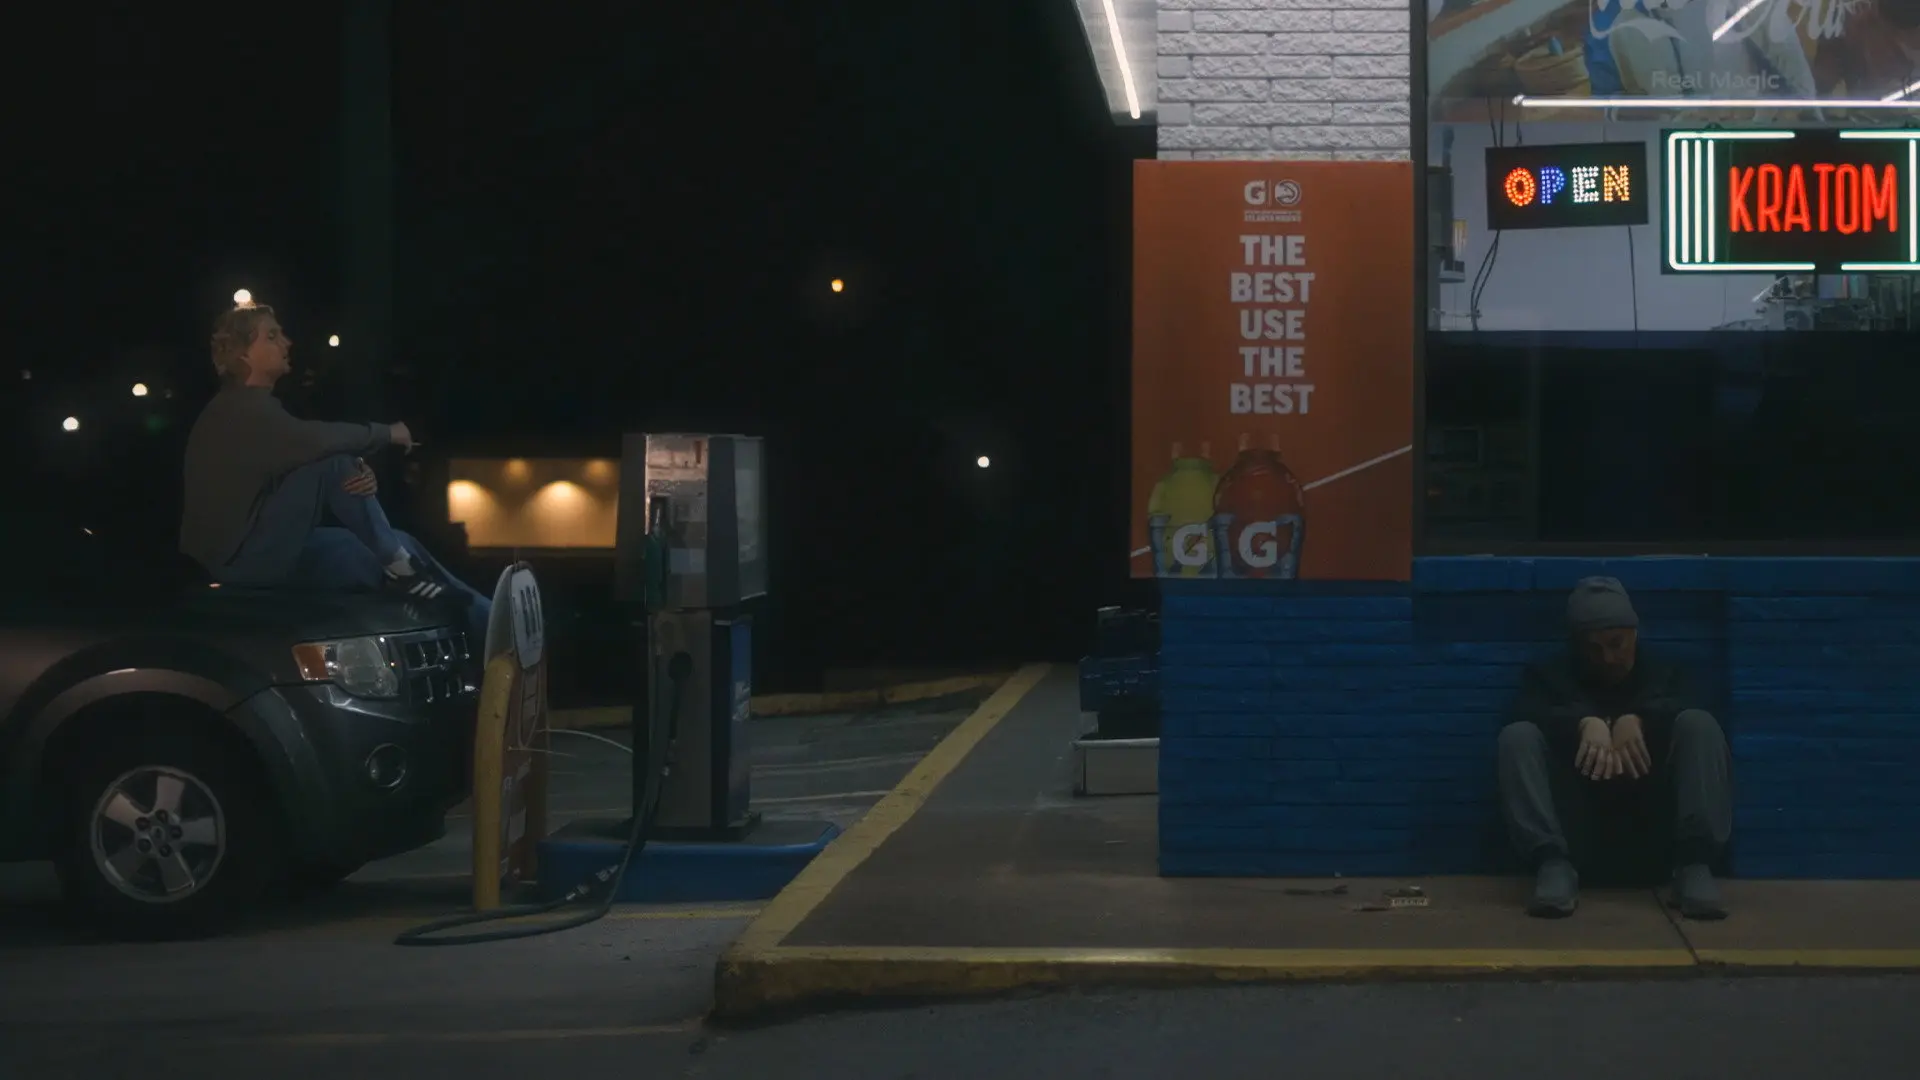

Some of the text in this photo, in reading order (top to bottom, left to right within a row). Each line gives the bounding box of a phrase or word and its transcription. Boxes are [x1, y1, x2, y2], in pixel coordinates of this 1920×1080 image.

[1651, 69, 1781, 92] Real Magic
[1244, 180, 1266, 205] G
[1504, 165, 1630, 207] OPEN
[1729, 163, 1898, 235] KRATOM
[1239, 234, 1306, 265] THE
[1230, 272, 1315, 303] BEST
[1240, 309, 1306, 340] USE
[1239, 346, 1305, 377] THE
[1230, 383, 1315, 415] BEST
[1172, 523, 1208, 566] G
[1238, 521, 1278, 568] G
